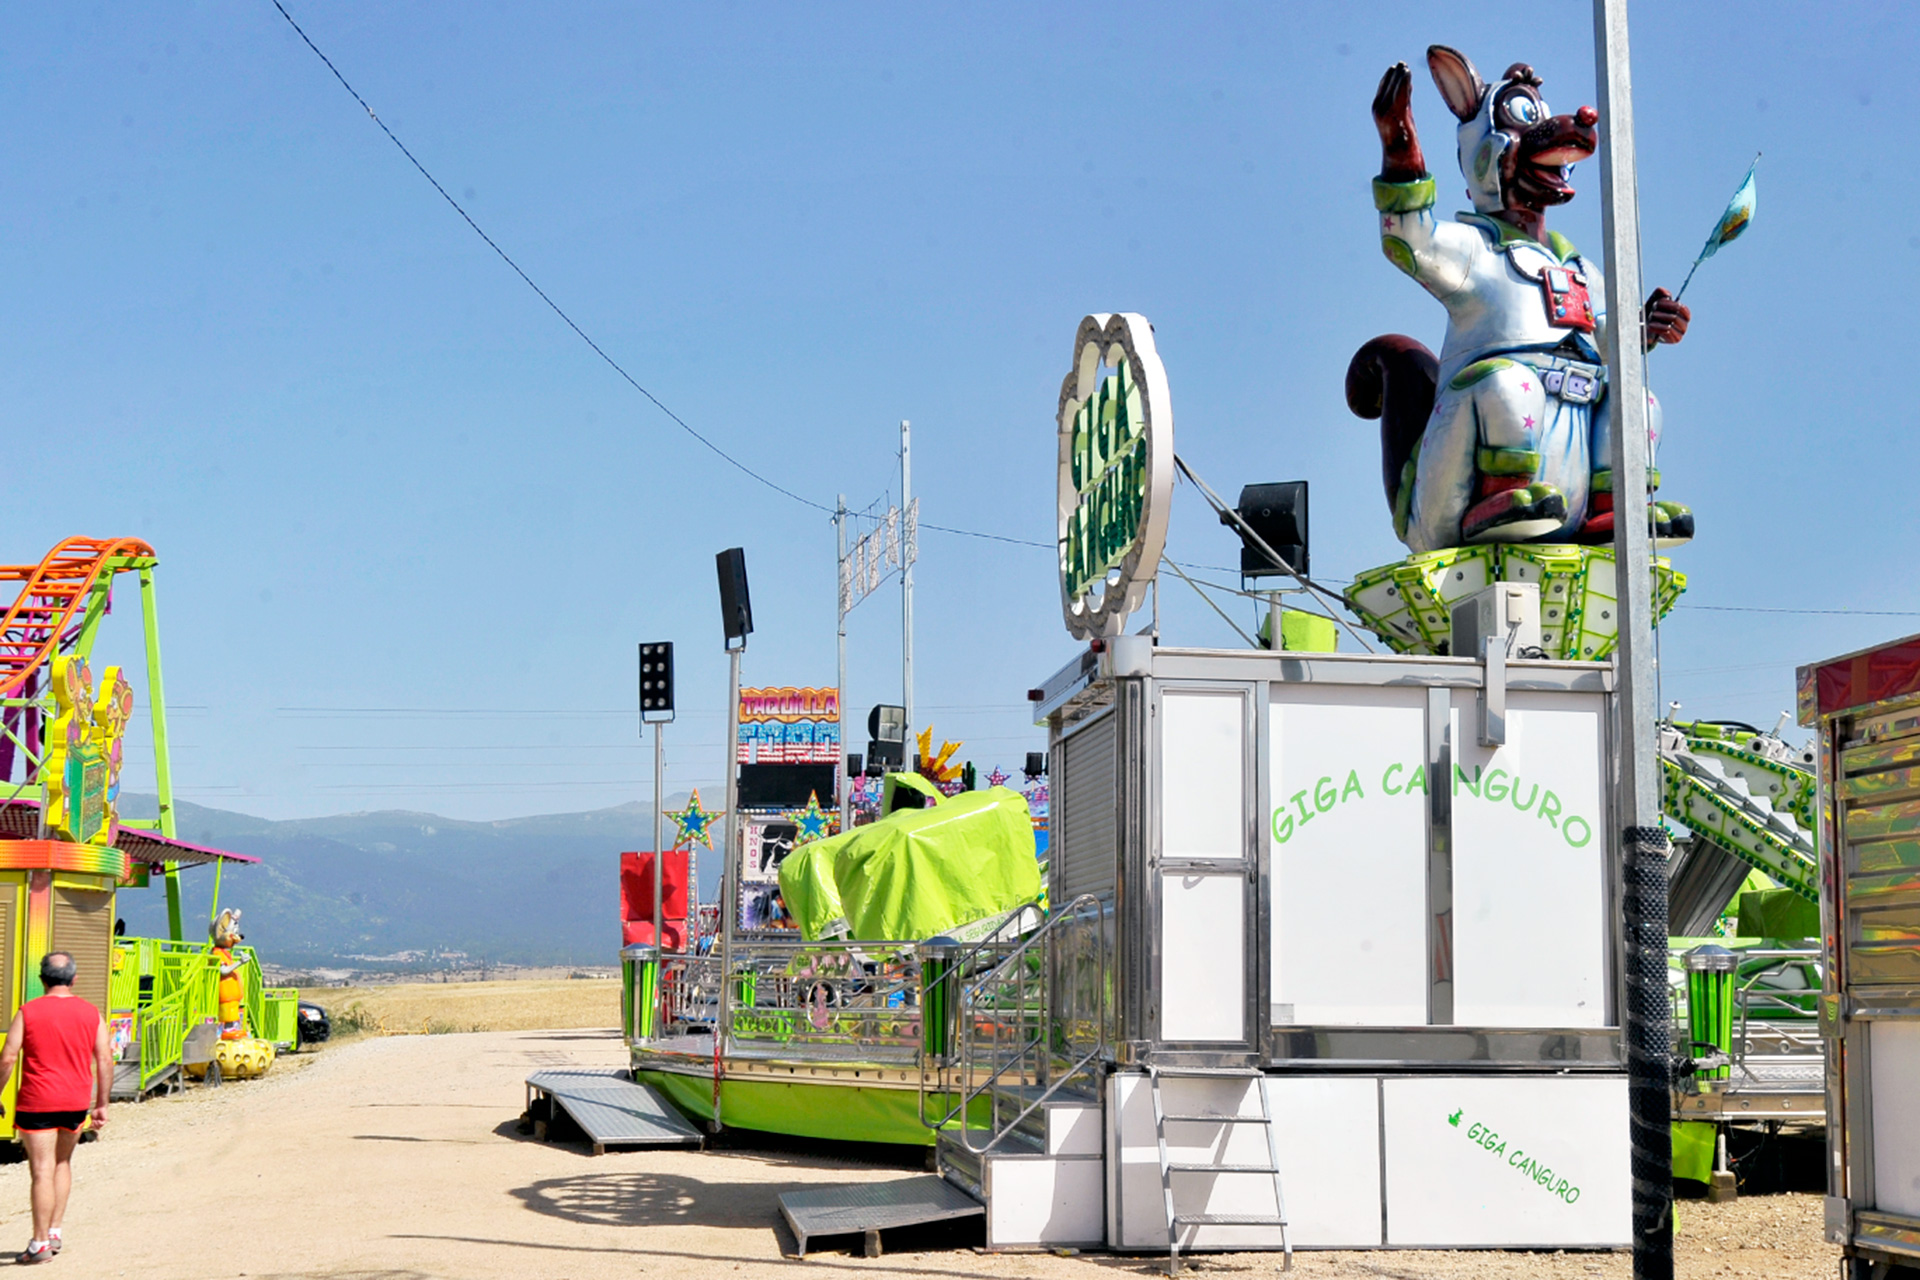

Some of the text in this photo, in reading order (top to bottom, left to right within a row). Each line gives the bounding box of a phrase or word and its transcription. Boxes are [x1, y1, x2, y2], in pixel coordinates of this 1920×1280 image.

[741, 692, 838, 716] TAQUILLA
[737, 723, 841, 765] TORO
[1272, 763, 1591, 848] GIGA CANGURO
[1466, 1121, 1581, 1204] GIGA CANGURO
